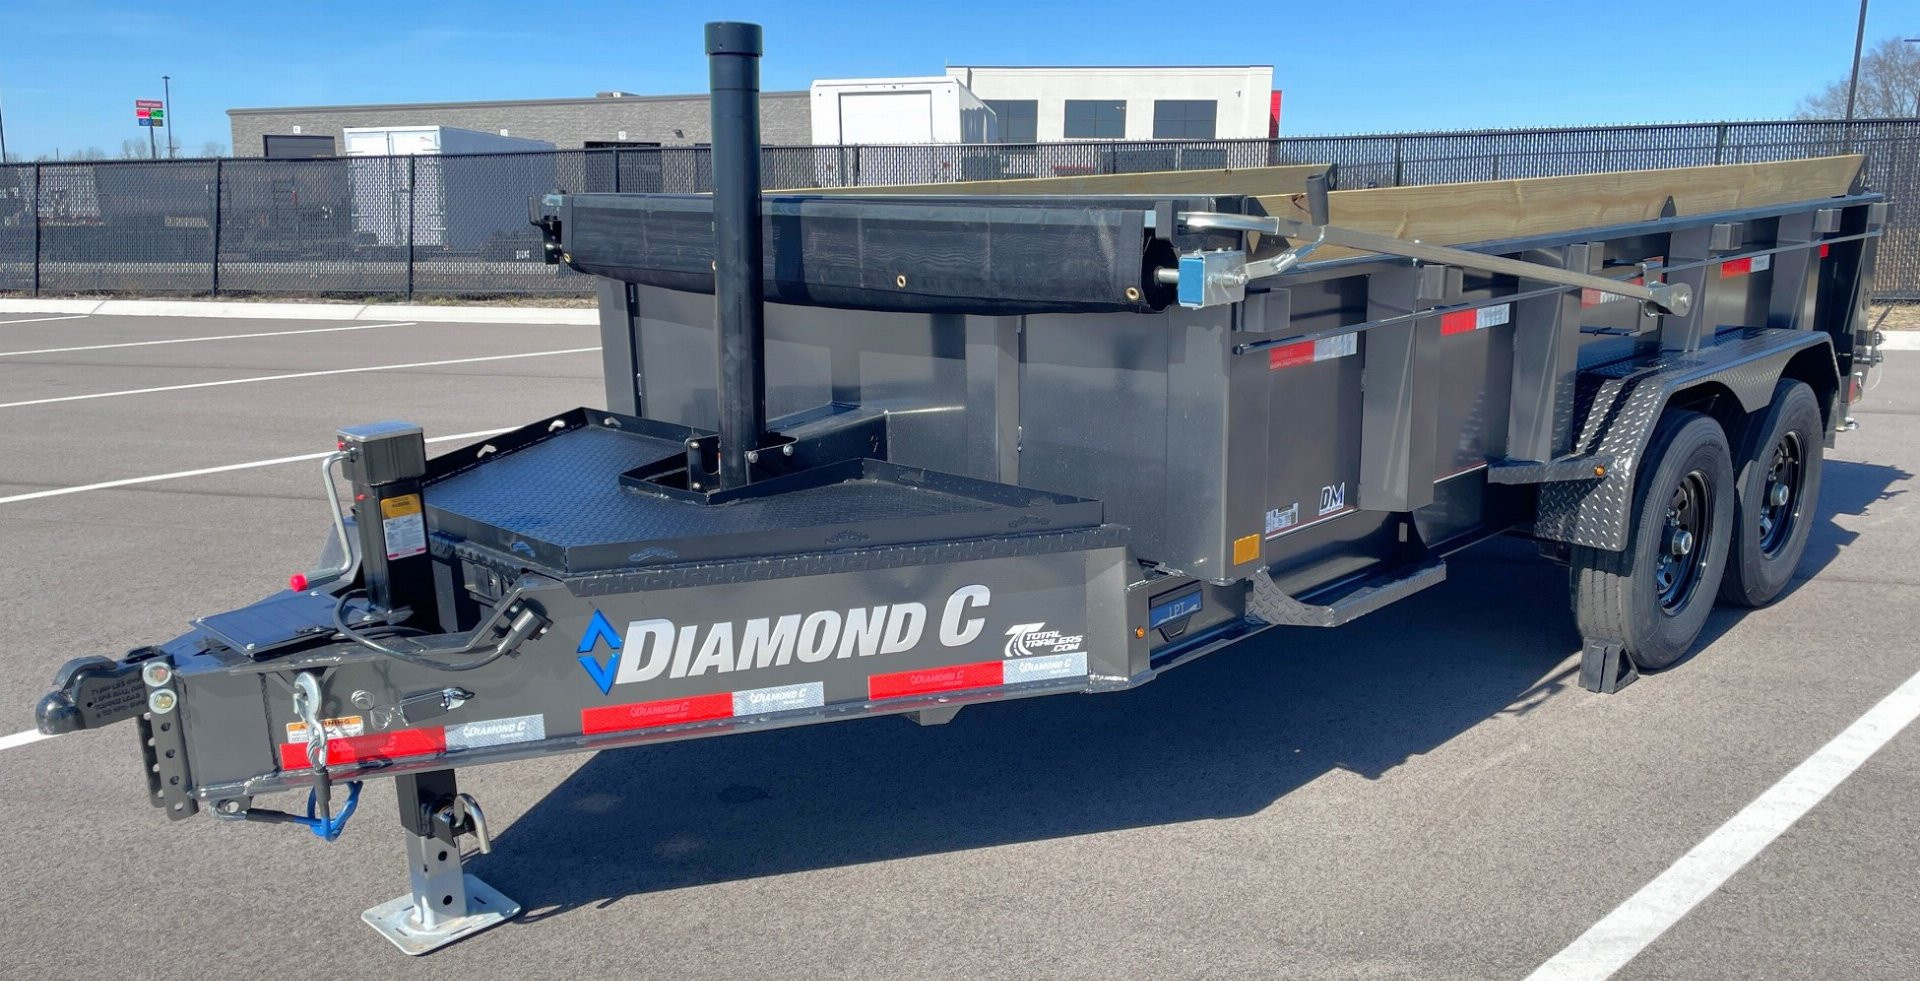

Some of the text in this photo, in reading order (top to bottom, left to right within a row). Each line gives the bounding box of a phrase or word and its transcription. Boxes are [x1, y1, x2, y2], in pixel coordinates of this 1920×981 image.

[1320, 482, 1344, 511] DM
[1169, 601, 1185, 617] LPT
[615, 584, 991, 685] DIAMOND C
[1026, 630, 1062, 640] TOTAL
[1025, 635, 1083, 648] TRAILERS
[1050, 643, 1080, 652] .COM
[1064, 658, 1072, 668] C
[799, 688, 808, 698] C
[470, 725, 516, 736] DIAMOND
[517, 721, 526, 731] C
